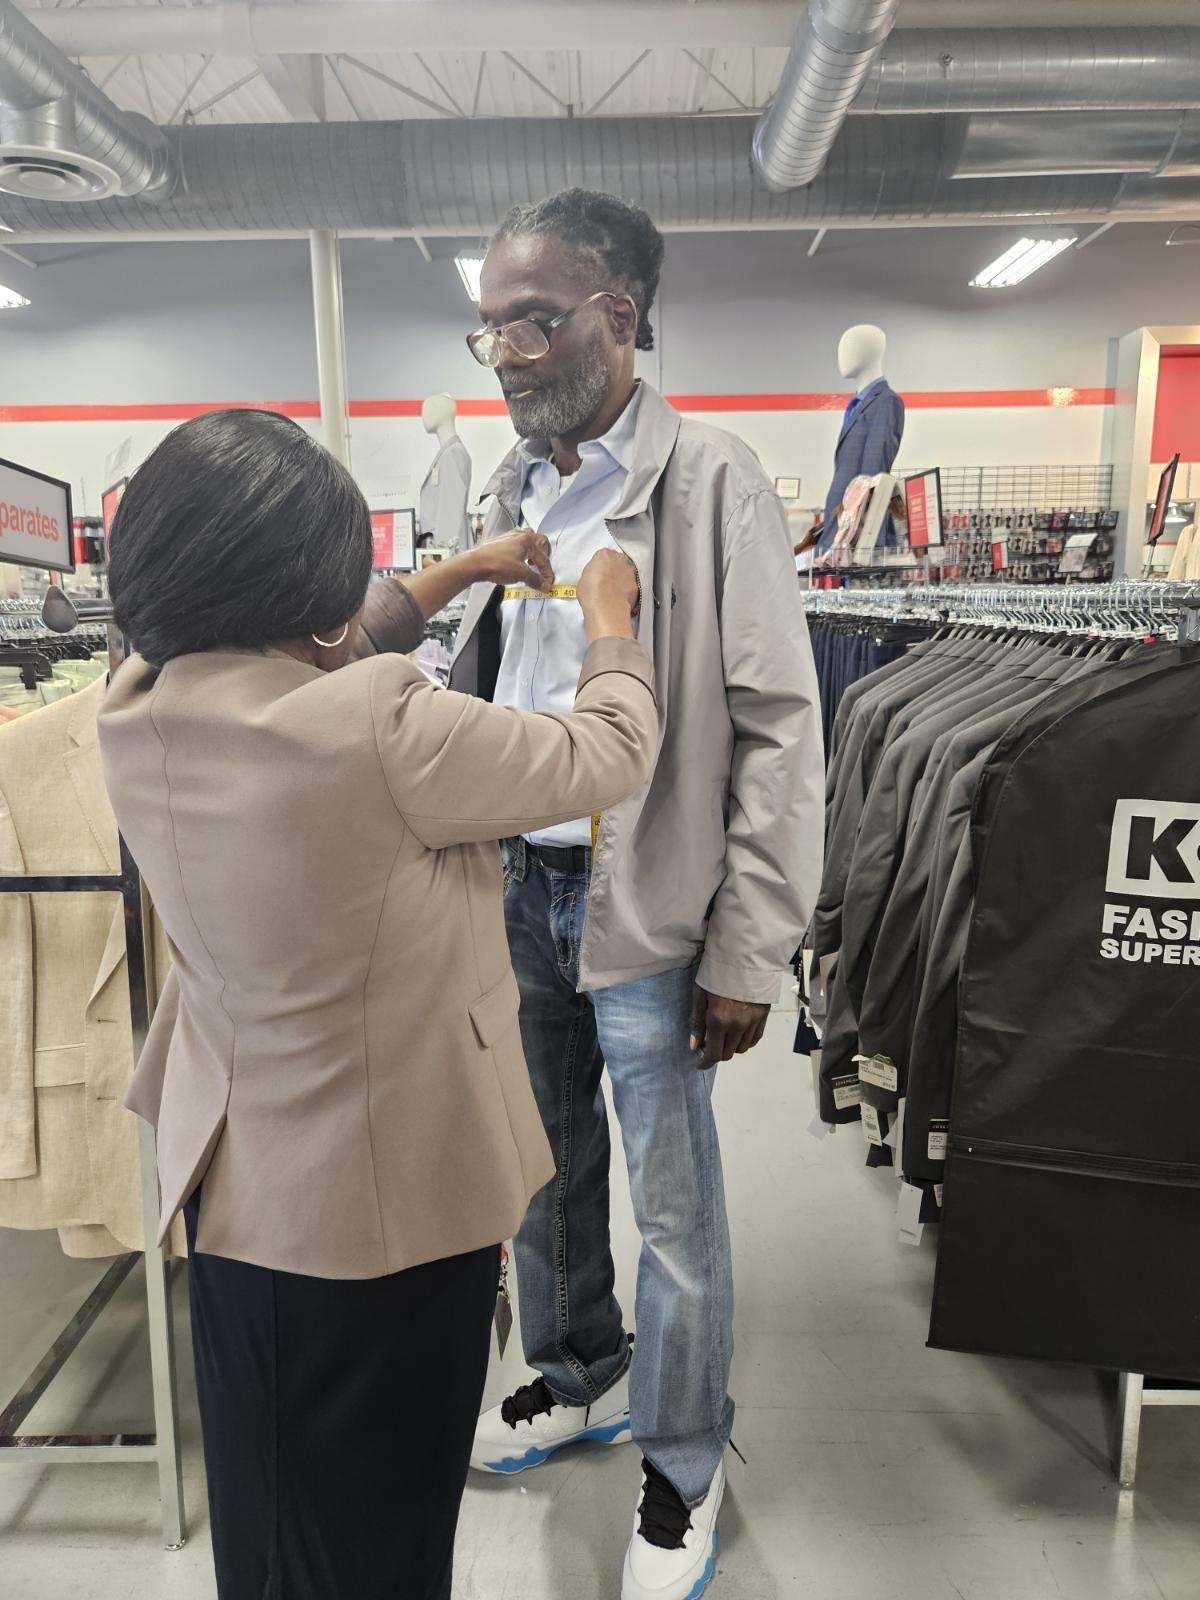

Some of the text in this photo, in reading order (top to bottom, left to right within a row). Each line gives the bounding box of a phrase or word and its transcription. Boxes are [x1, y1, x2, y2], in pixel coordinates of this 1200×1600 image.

[564, 589, 575, 597] 40
[1126, 815, 1200, 884] K
[1100, 938, 1200, 966] SUPER
